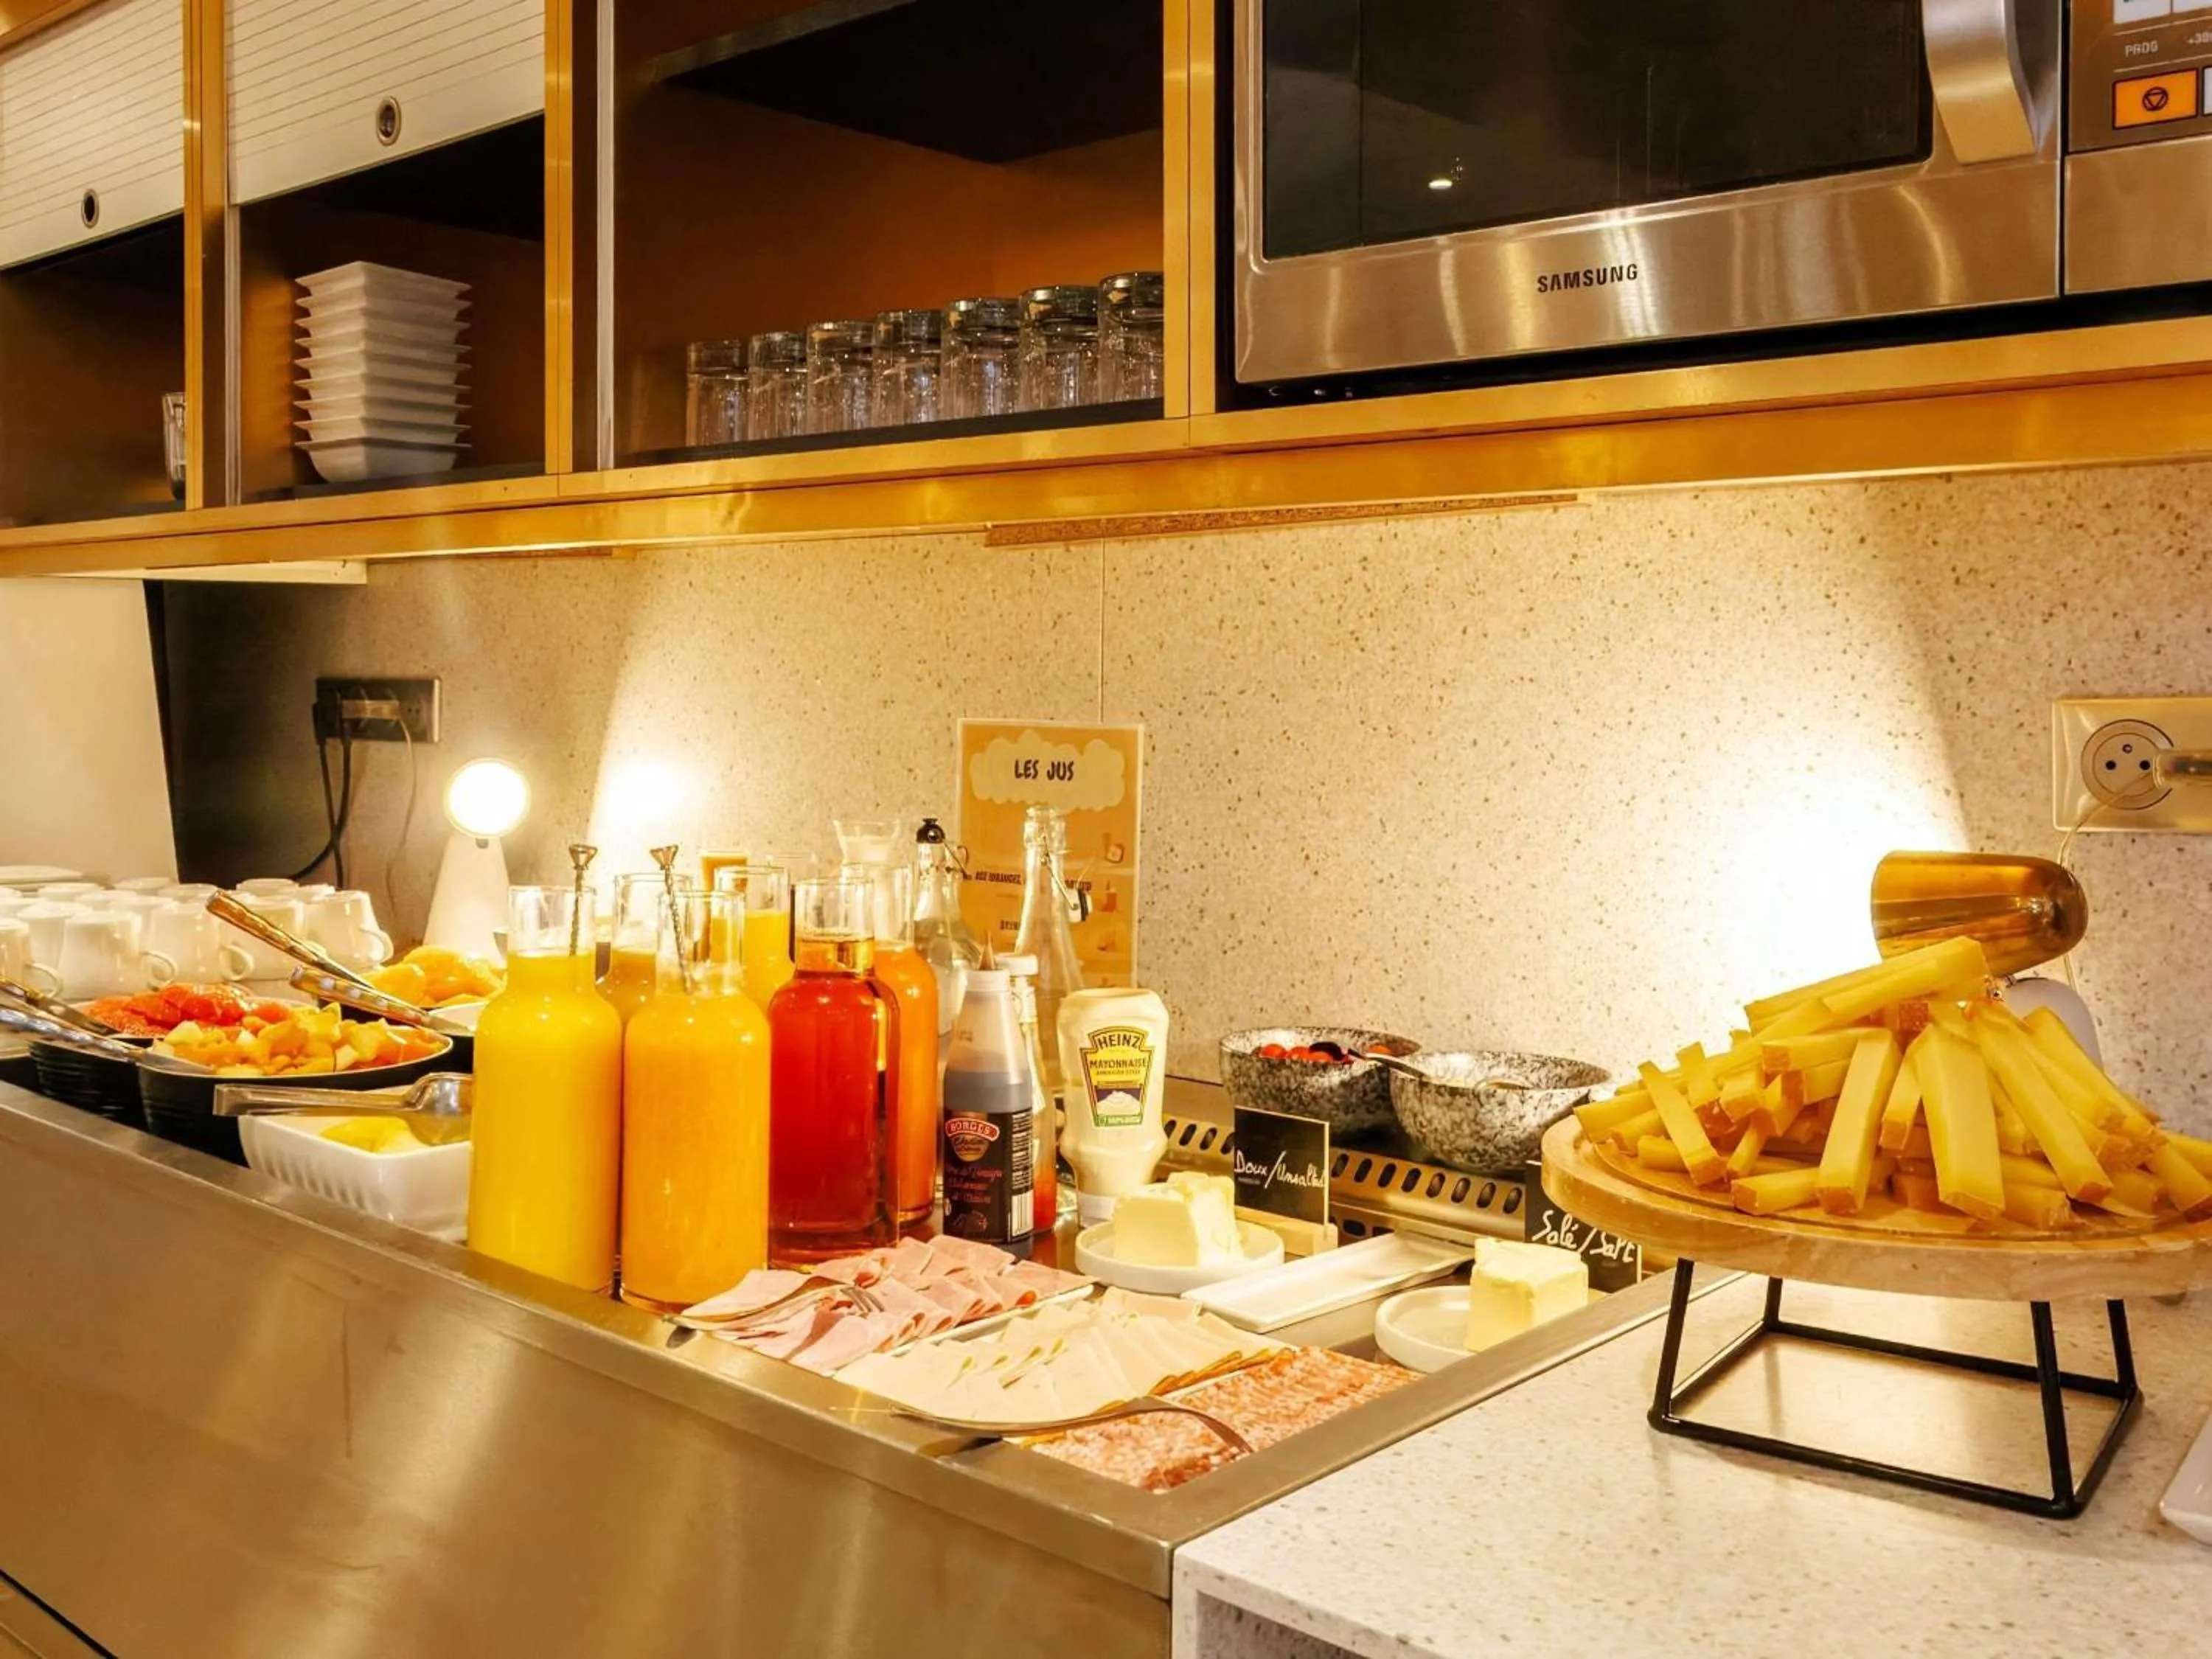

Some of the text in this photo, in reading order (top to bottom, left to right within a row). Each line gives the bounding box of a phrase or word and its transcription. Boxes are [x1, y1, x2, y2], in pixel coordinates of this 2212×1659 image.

[2124, 40, 2158, 58] PROG
[1537, 263, 1638, 293] SAMSUNG
[1015, 759, 1074, 781] LES JUS
[1097, 1033, 1141, 1050] HEINZ
[1089, 1058, 1147, 1069] MAYONNAISE
[950, 1121, 991, 1135] BORGES
